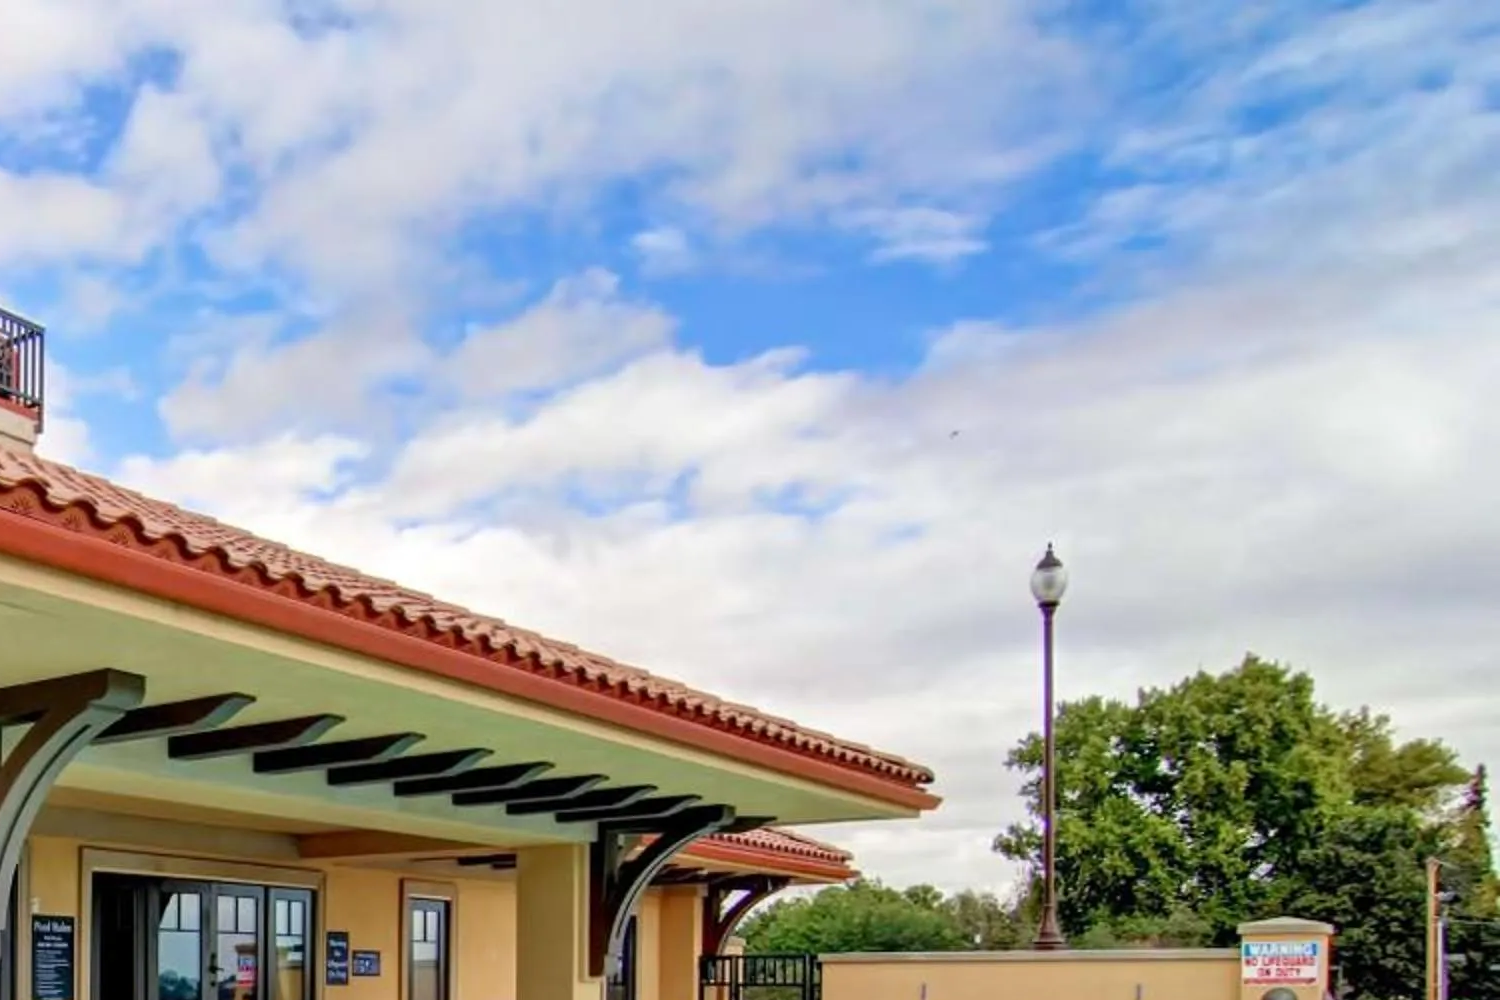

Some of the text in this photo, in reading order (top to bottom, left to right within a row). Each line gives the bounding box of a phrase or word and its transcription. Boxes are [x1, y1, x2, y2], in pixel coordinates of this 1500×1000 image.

[1248, 943, 1313, 957] WARNING
[1245, 956, 1315, 967] NO LIFEGUARD
[1257, 967, 1301, 977] ON DUTY
